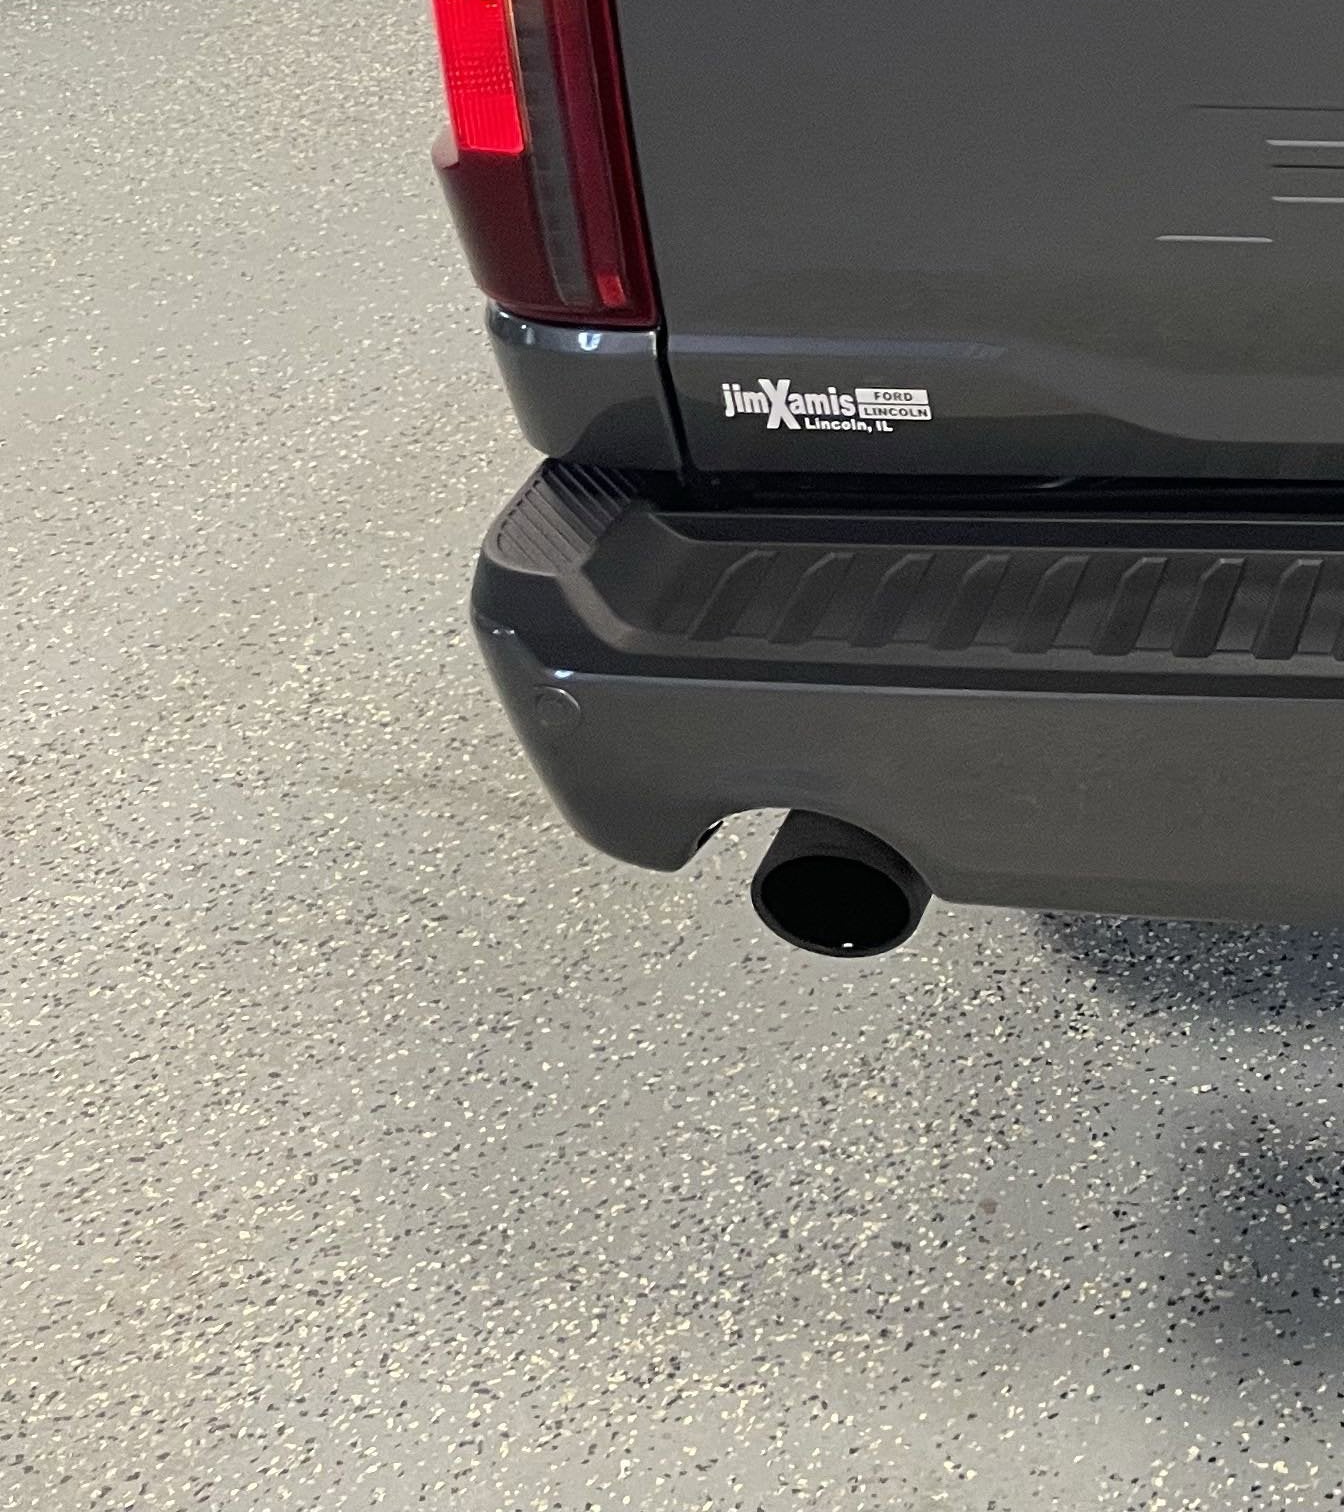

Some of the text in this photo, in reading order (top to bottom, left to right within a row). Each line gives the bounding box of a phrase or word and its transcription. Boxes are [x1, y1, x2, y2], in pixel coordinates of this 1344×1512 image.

[873, 391, 913, 402] FORD
[863, 407, 929, 418] LINCOLN
[804, 417, 894, 433] Lincoln, IL
